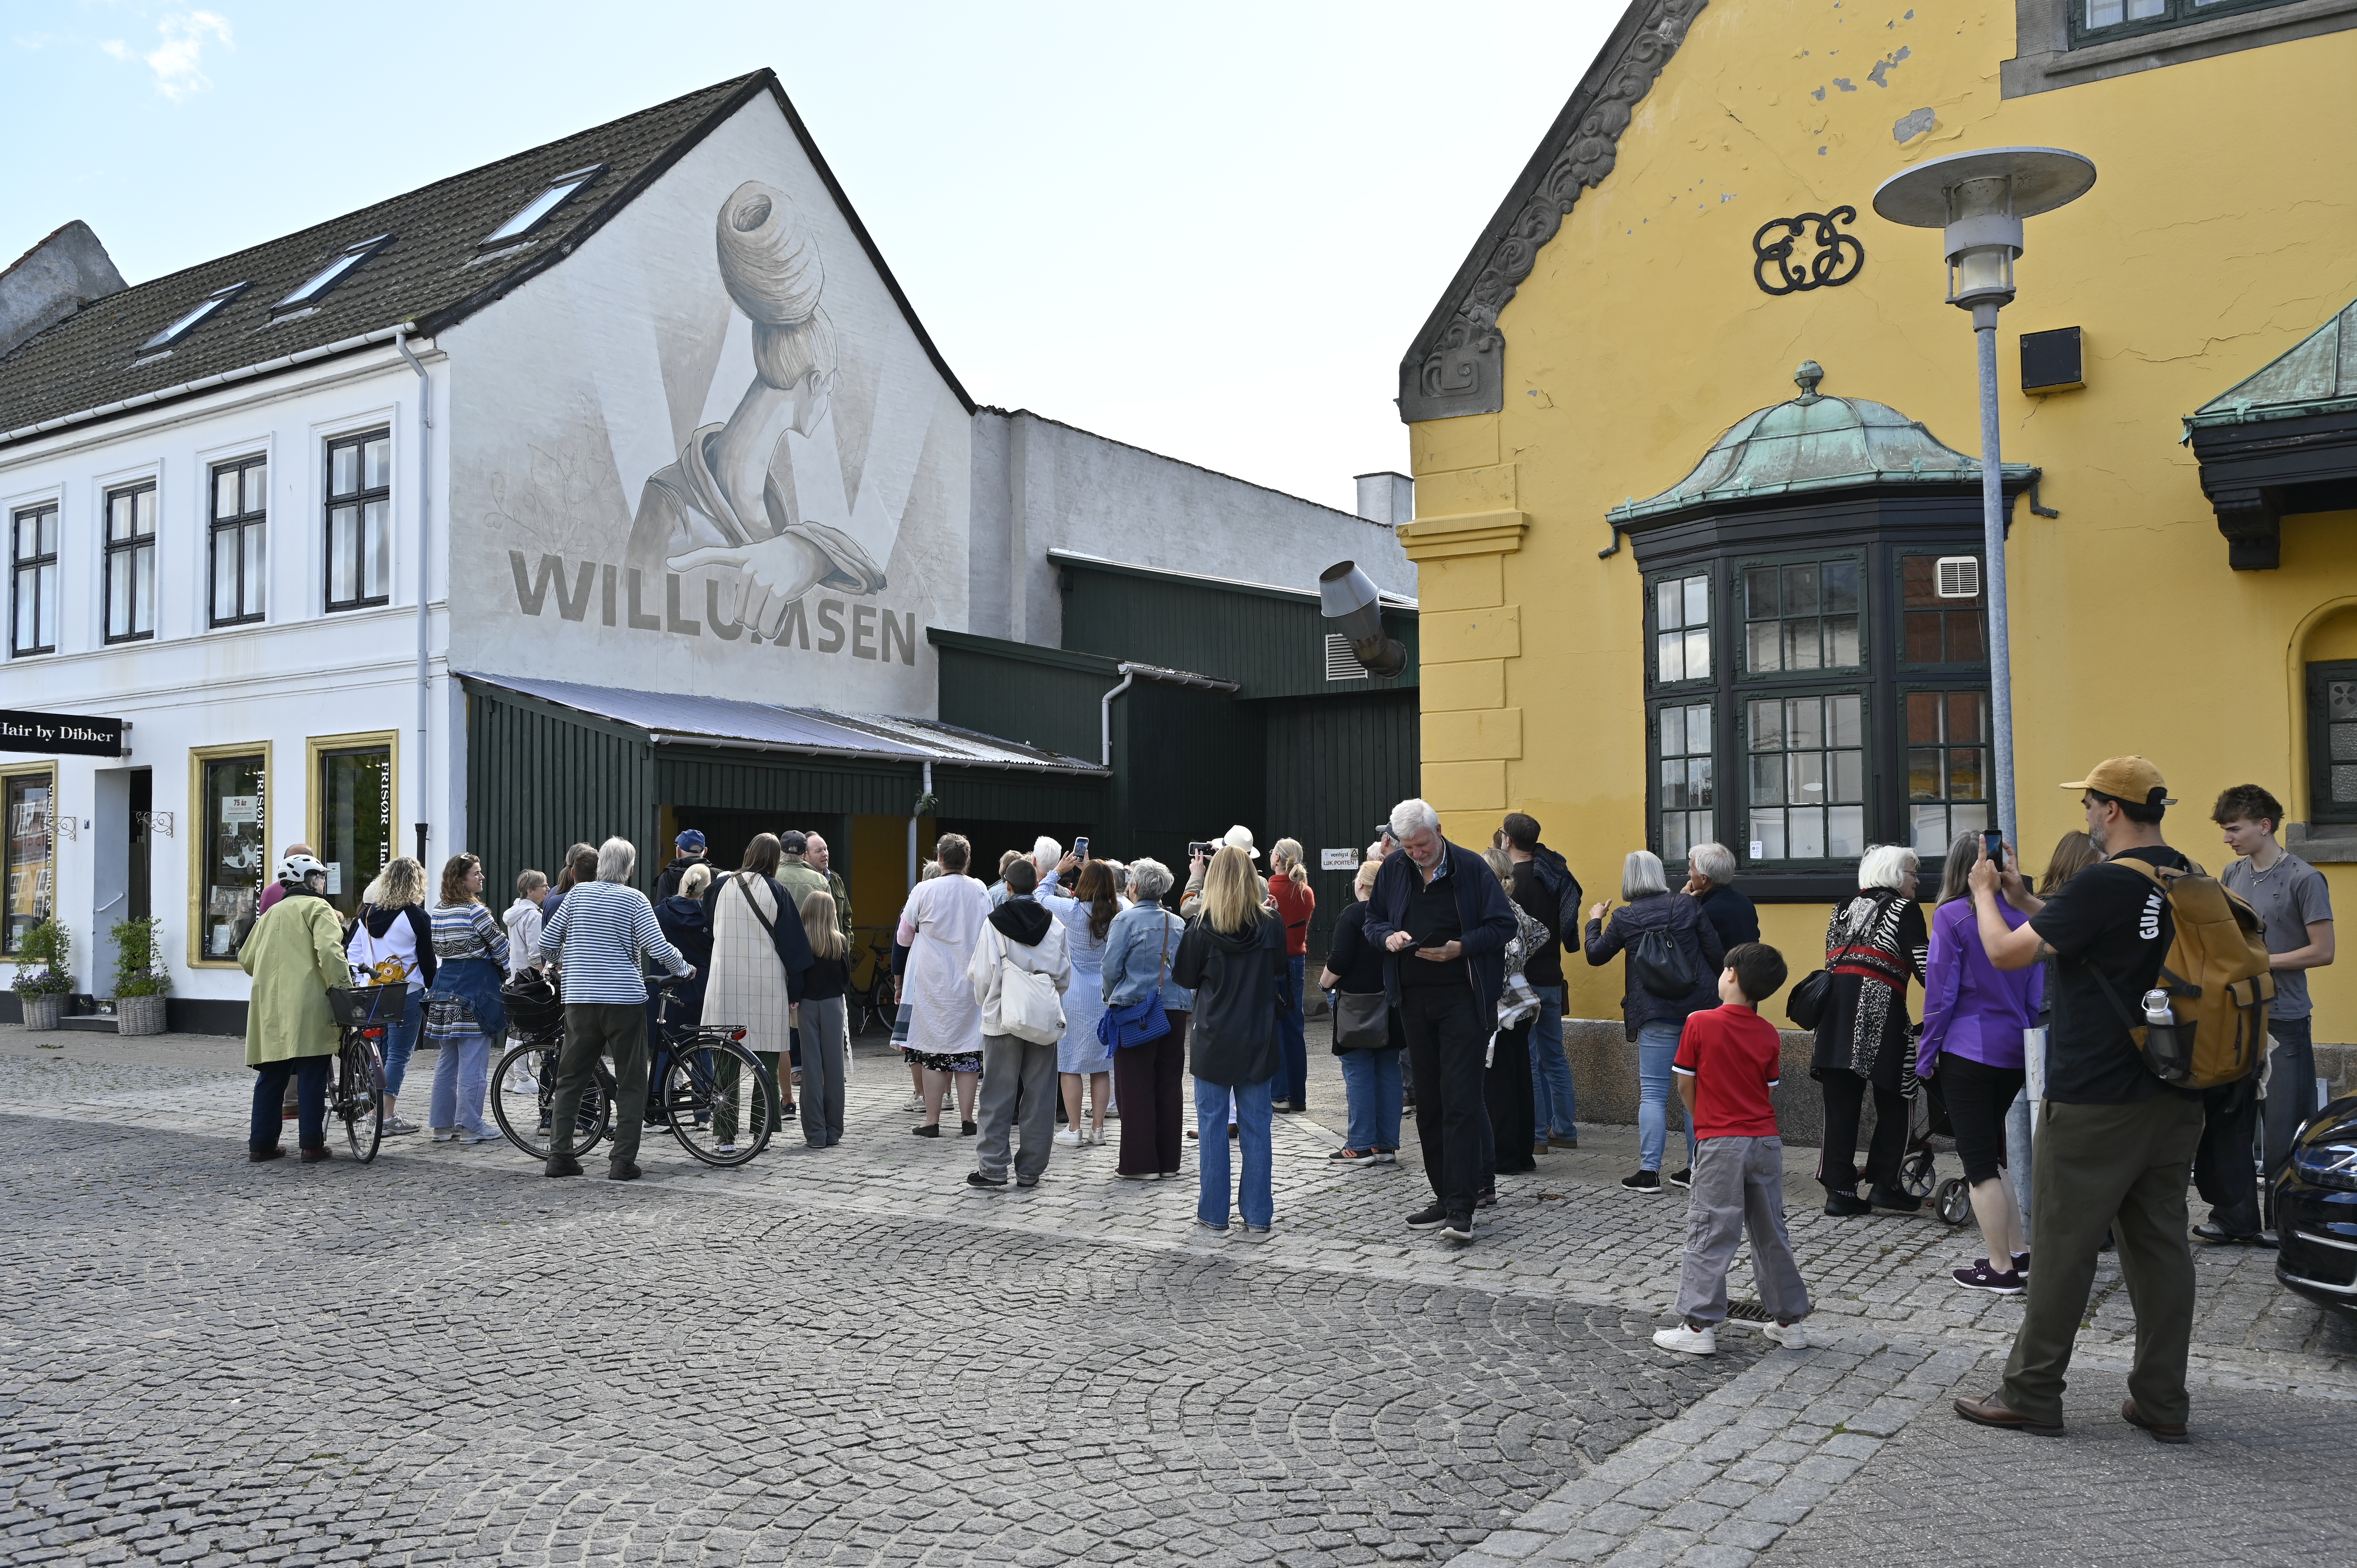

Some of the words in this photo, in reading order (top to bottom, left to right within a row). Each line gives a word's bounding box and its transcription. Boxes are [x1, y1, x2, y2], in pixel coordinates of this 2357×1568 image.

[0, 722, 32, 736] Hair
[36, 725, 55, 741] by
[59, 726, 113, 742] Dibber
[380, 761, 389, 826] FRISØR
[254, 878, 263, 895] by
